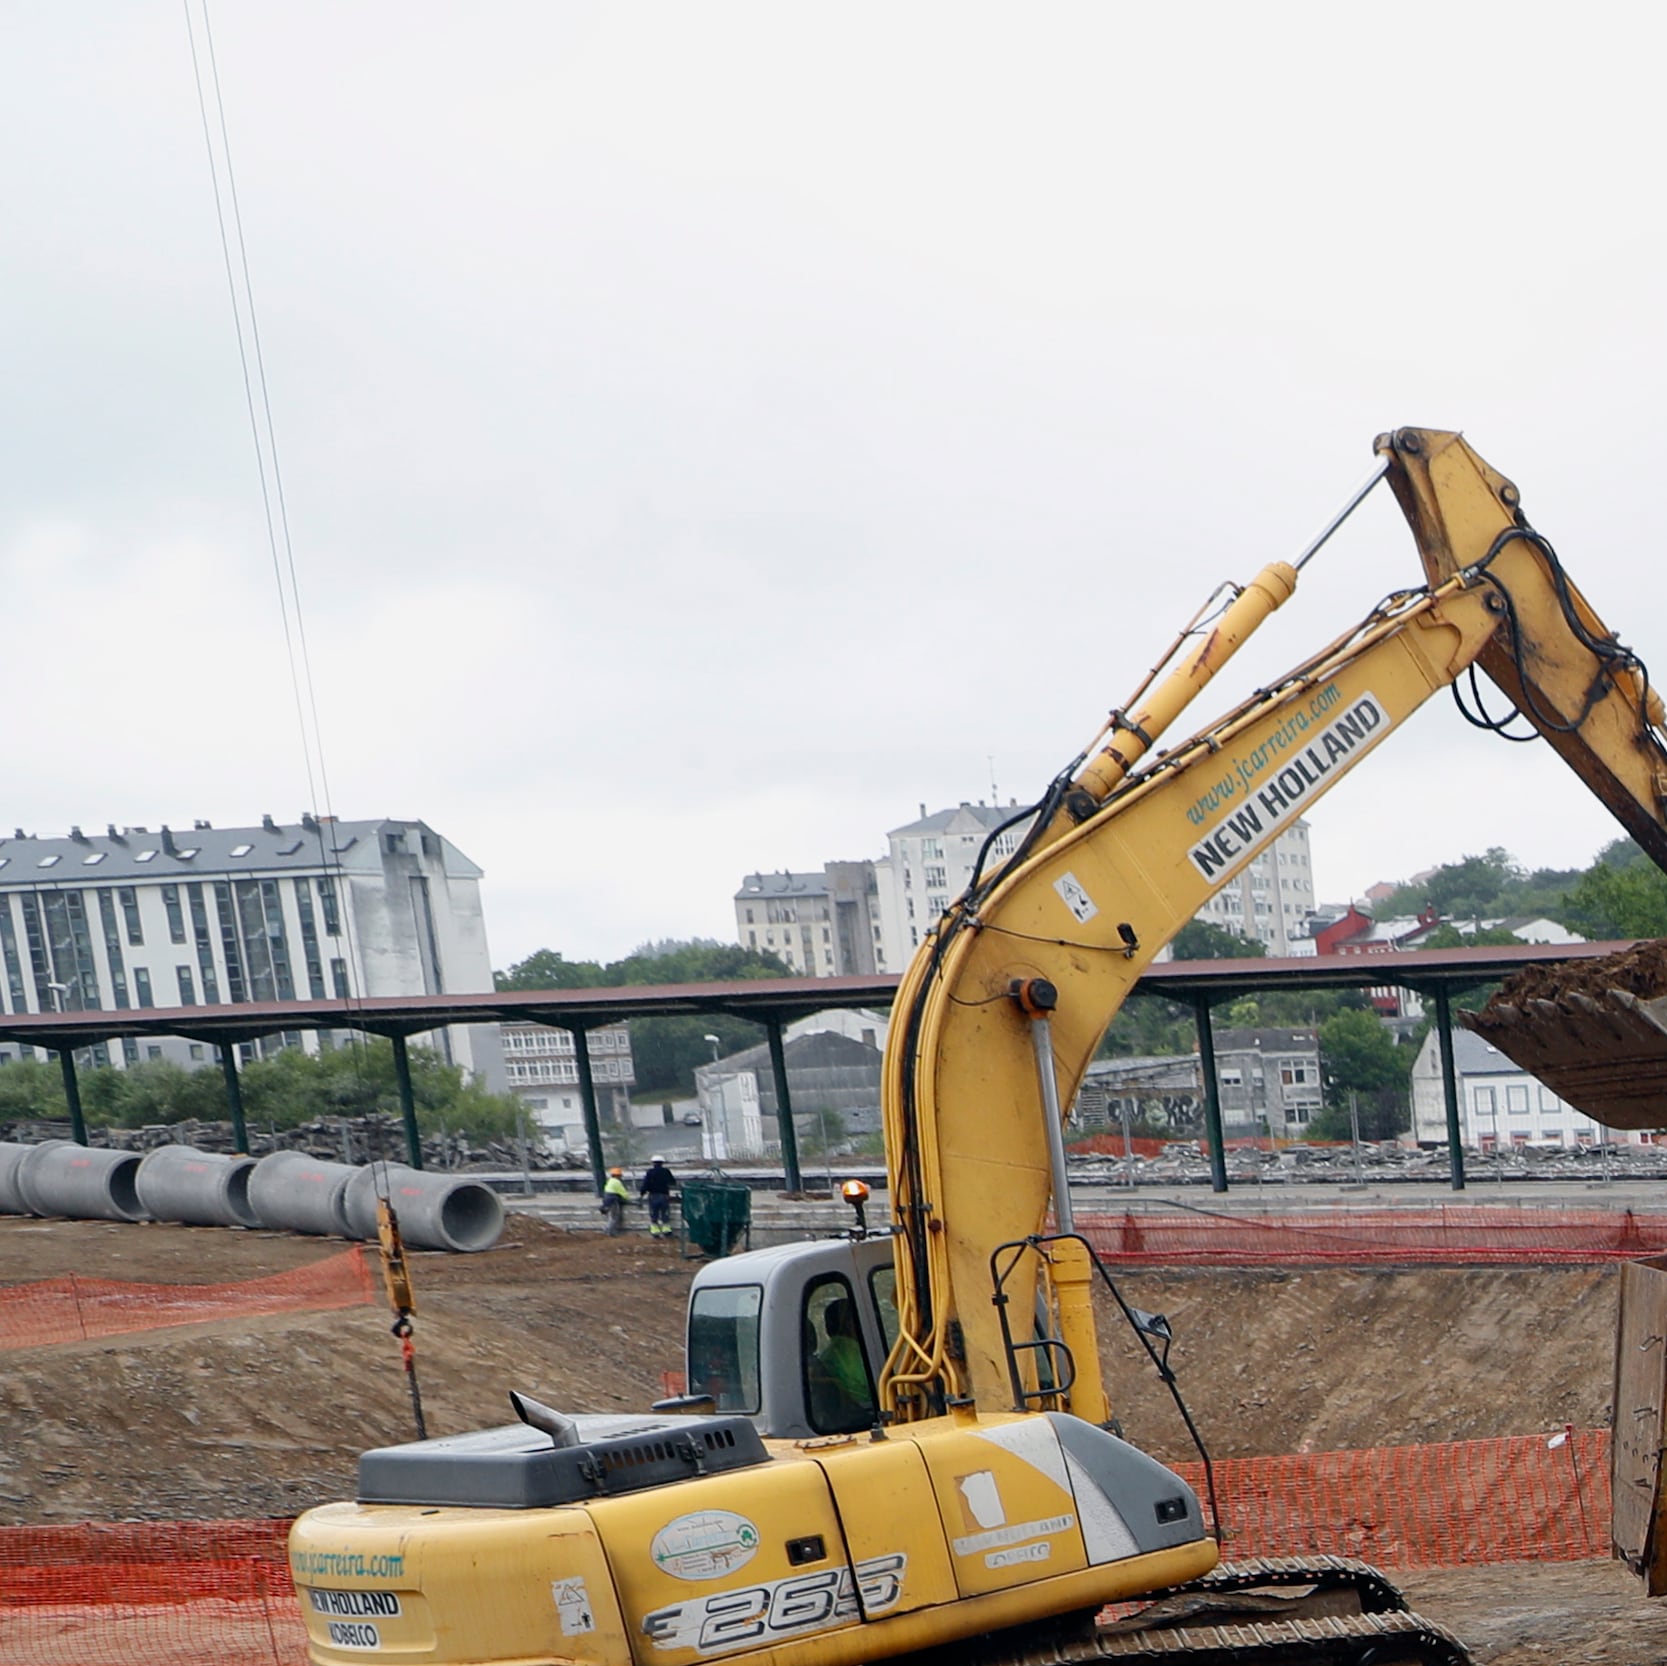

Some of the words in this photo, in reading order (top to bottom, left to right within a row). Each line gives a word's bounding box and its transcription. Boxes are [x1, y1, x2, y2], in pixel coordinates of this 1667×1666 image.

[1186, 682, 1342, 826] www.jcarreira.com
[1192, 803, 1264, 877] NEW
[1257, 699, 1381, 818] HOLLAND
[331, 1591, 398, 1615] HOLLAND
